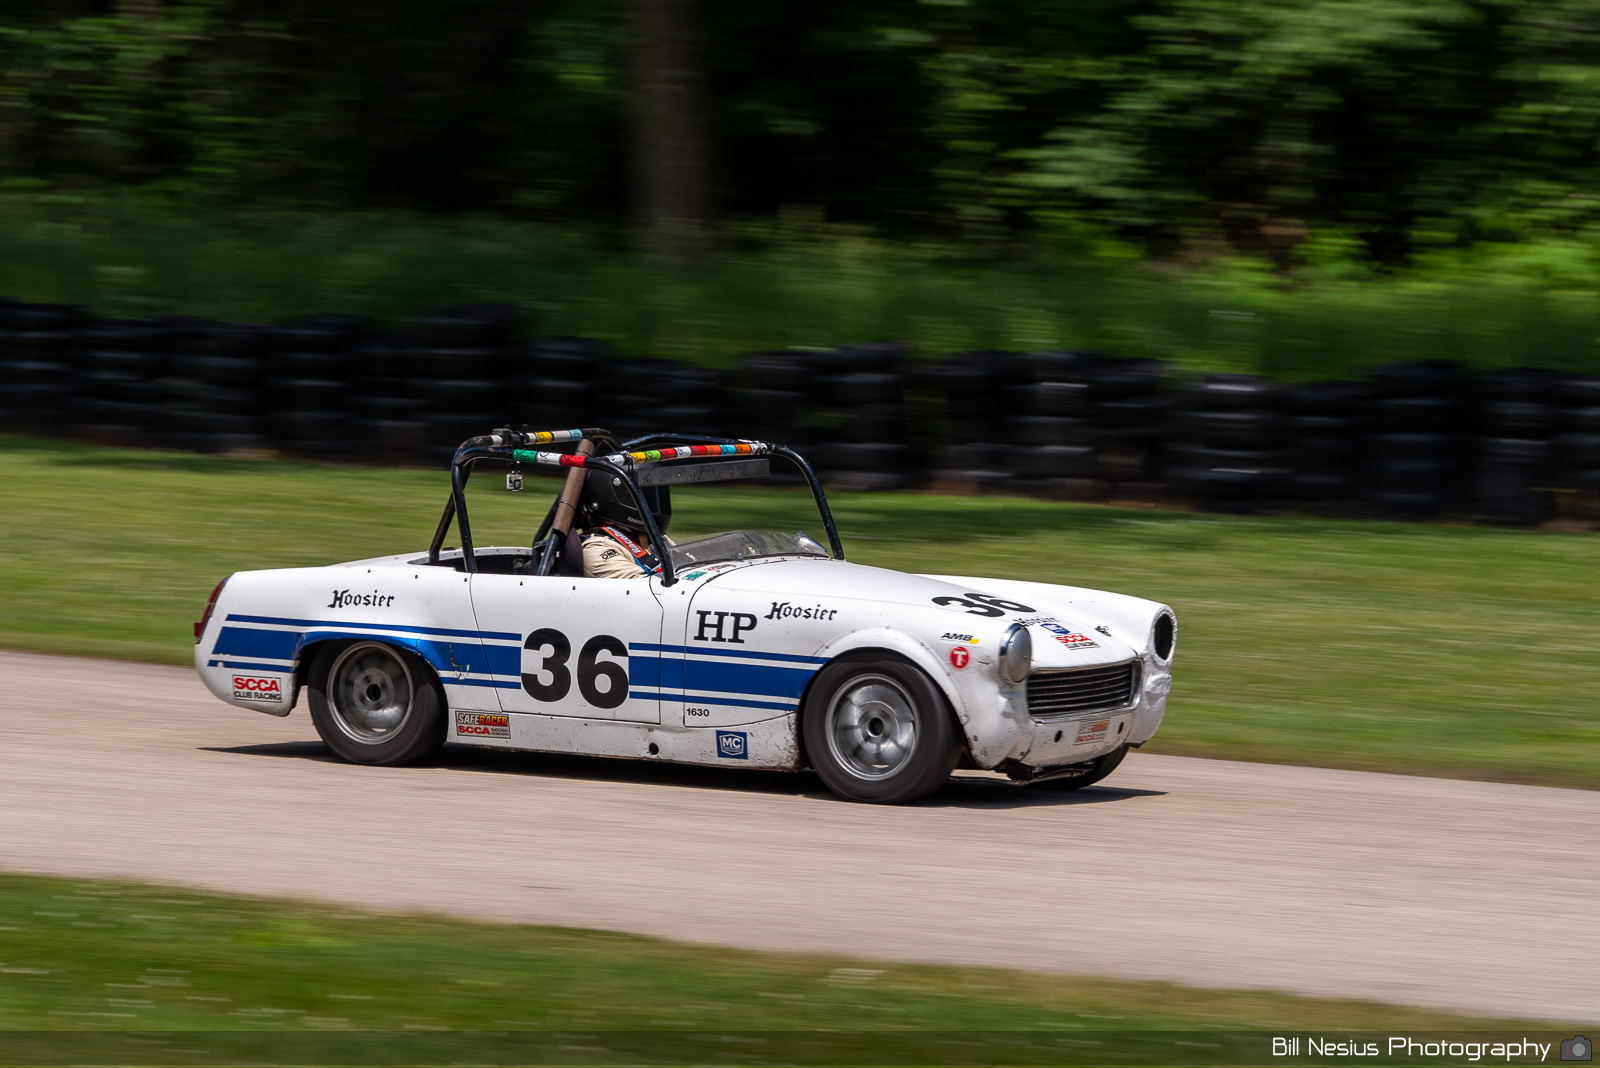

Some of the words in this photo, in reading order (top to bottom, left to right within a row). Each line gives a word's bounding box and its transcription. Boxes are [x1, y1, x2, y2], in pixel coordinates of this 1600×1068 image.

[327, 589, 395, 608] Hoosier
[931, 592, 1037, 618] 36
[764, 602, 838, 621] Hoosier
[693, 610, 758, 644] HP
[940, 632, 973, 641] AMB
[520, 628, 630, 709] 36
[233, 677, 280, 692] SCCA
[234, 690, 253, 699] CLUB
[253, 692, 282, 701] RACING
[686, 707, 710, 717] 1630
[458, 725, 491, 735] SCCA
[722, 737, 742, 749] MC
